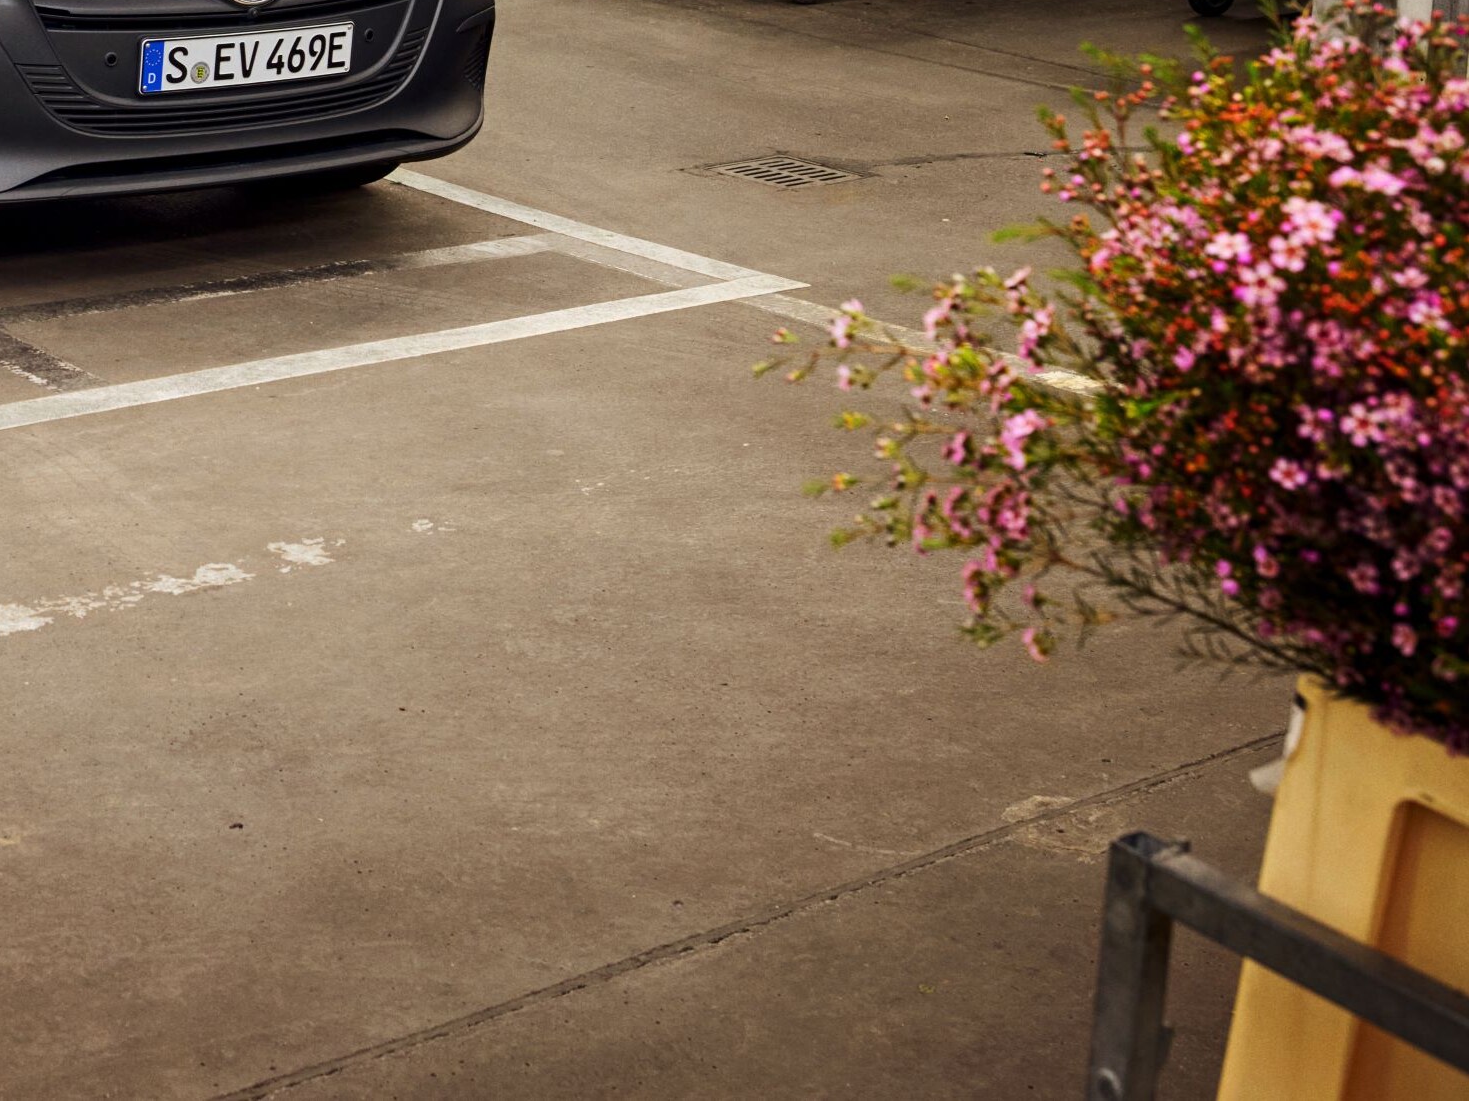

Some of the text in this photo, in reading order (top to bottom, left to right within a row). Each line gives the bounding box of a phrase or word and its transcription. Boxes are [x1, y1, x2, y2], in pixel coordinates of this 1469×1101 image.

[165, 31, 347, 84] S EV 469E
[147, 72, 157, 84] D
